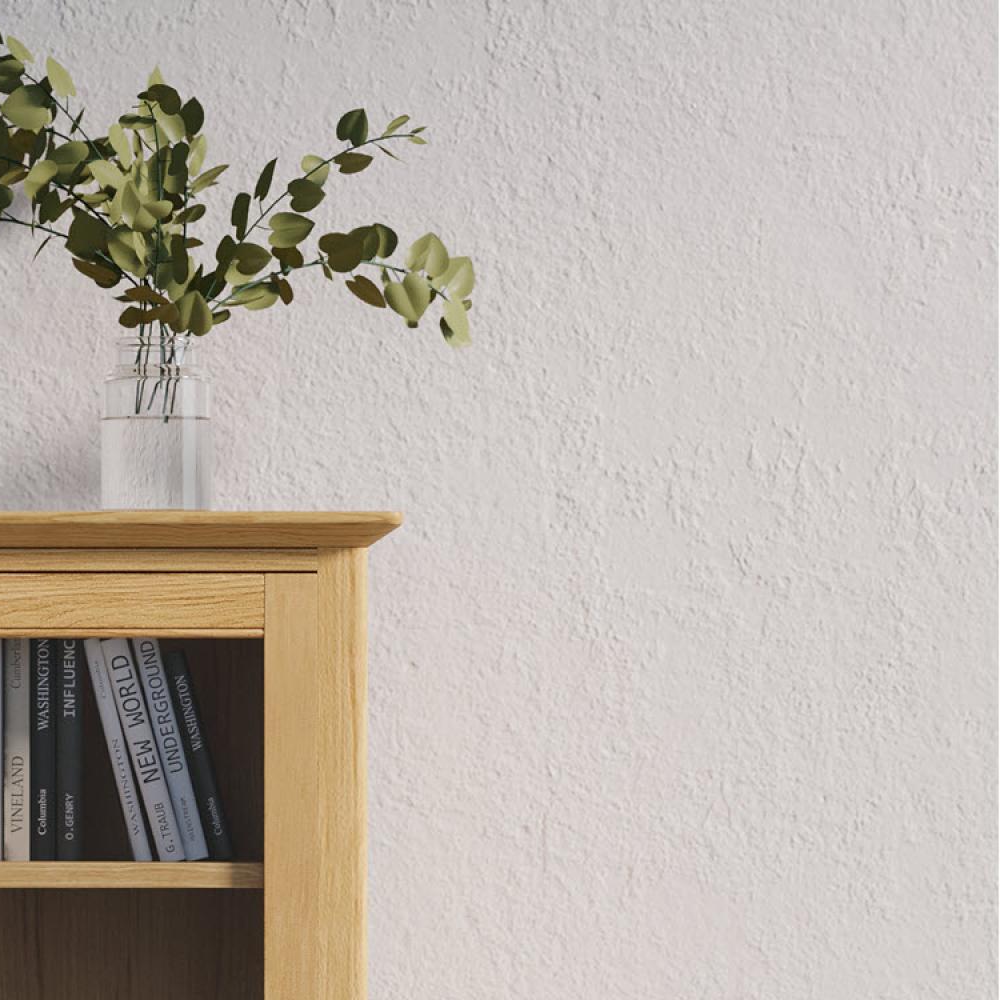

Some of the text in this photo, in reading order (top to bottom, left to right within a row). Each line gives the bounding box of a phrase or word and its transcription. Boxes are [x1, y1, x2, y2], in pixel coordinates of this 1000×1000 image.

[111, 655, 145, 729] WORLD
[140, 640, 183, 774] UNDERGROUND
[175, 674, 204, 752] WASHINGTON
[37, 639, 50, 836] Columbia WASHINGTON
[63, 640, 76, 841] O.GENRY INFLUENC
[134, 739, 161, 784] NEW
[11, 755, 24, 833] VINELAND
[111, 738, 141, 837] WASHINGTON
[154, 802, 172, 838] TRAUB
